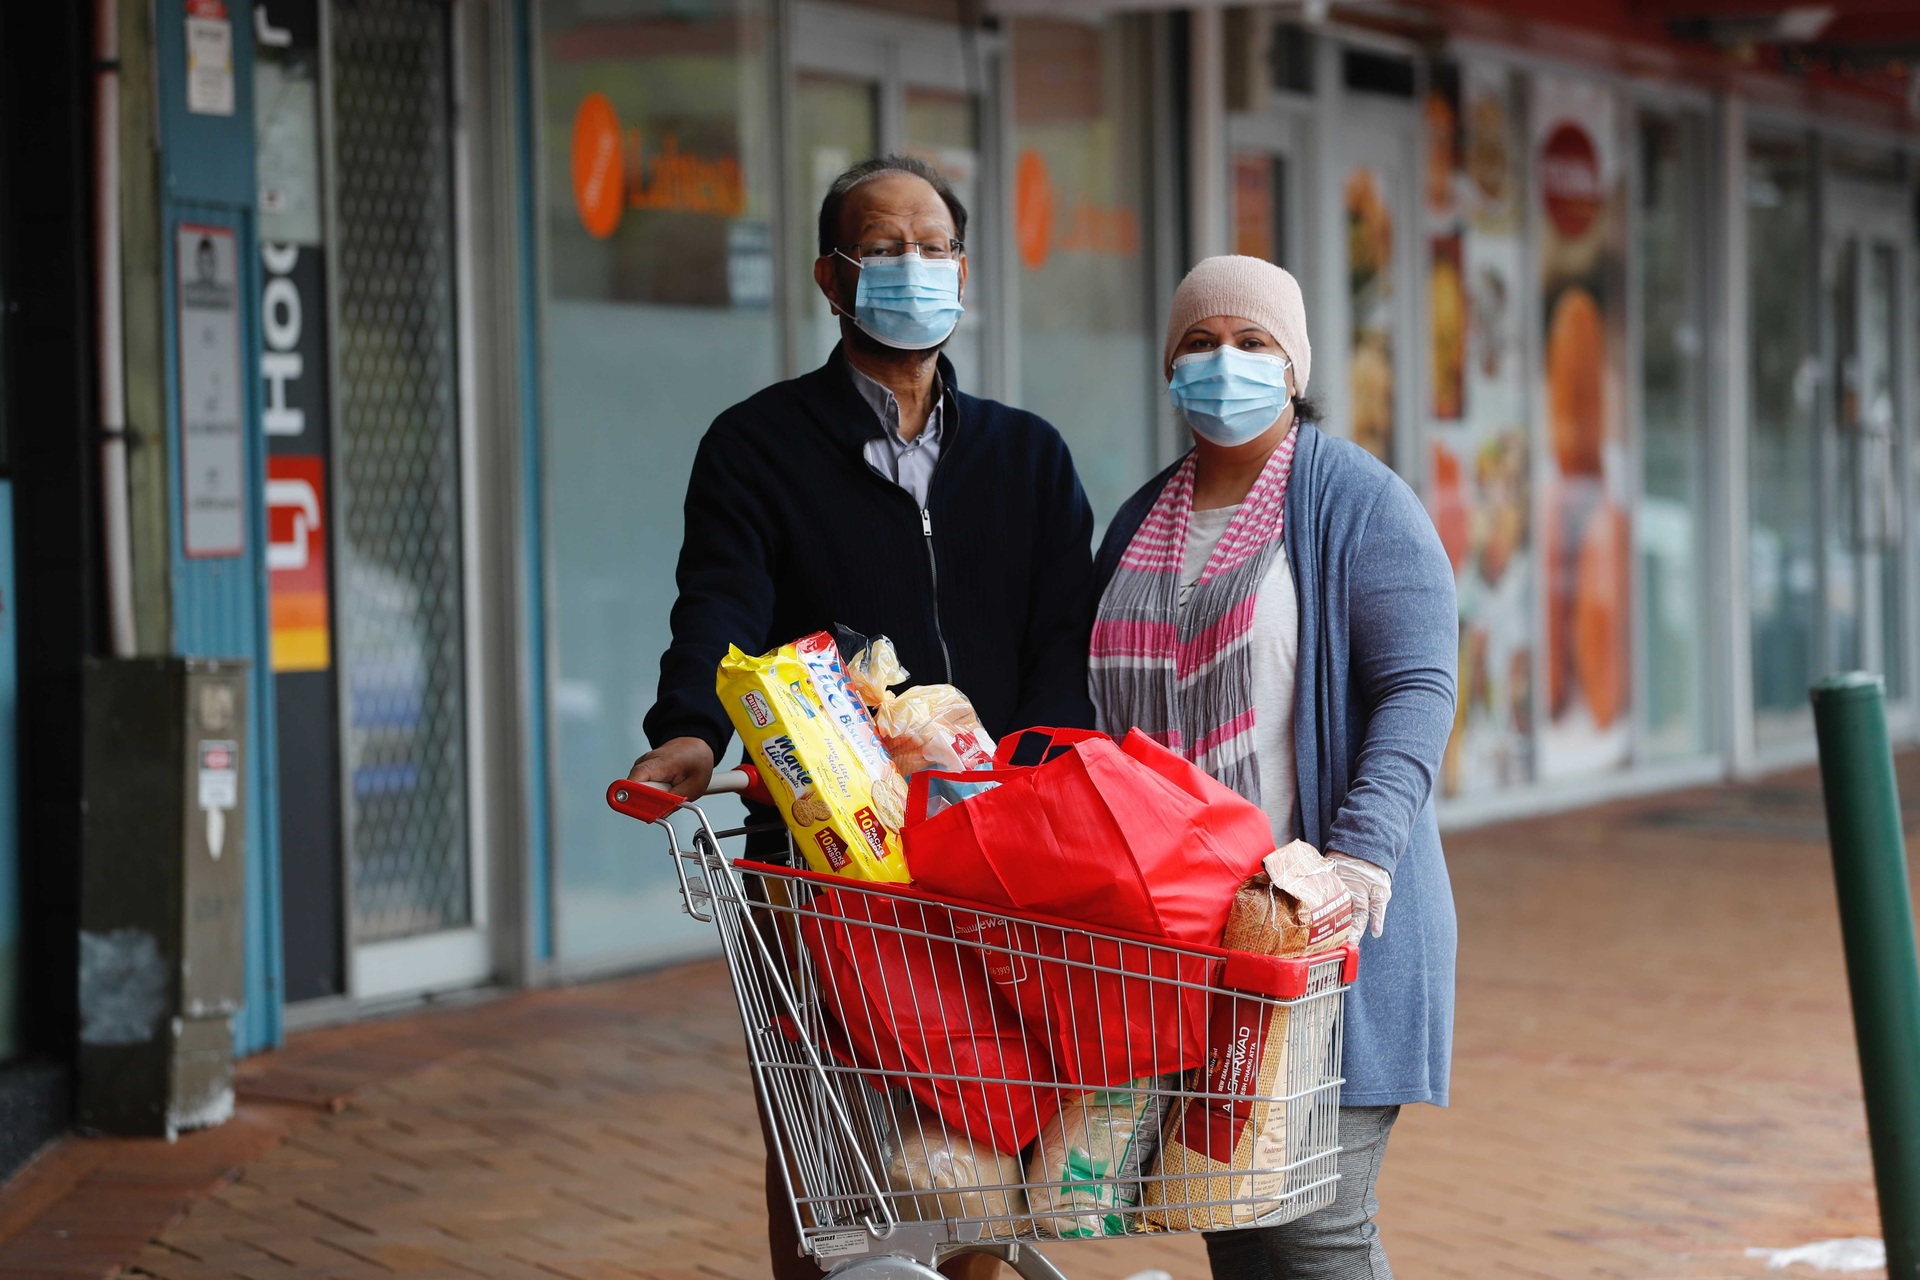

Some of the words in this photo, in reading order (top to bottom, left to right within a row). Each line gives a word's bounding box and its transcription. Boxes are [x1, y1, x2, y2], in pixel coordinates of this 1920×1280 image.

[839, 714, 877, 766] Biscuits
[765, 745, 784, 767] Lite
[780, 767, 800, 789] Biscuits
[775, 735, 813, 787] Marie
[826, 754, 840, 775] Stay
[838, 762, 850, 780] Lite
[859, 810, 873, 829] 10
[819, 829, 833, 846] 10
[864, 829, 882, 858] INSIDE
[869, 827, 885, 856] PACKS
[825, 845, 841, 868] INSIDE
[831, 842, 846, 866] PACKS
[1222, 1026, 1251, 1113] ASHIRWAD
[1243, 1061, 1253, 1083] CHAKKI
[1249, 1042, 1257, 1060] ATTA
[814, 1234, 836, 1243] wanzl
